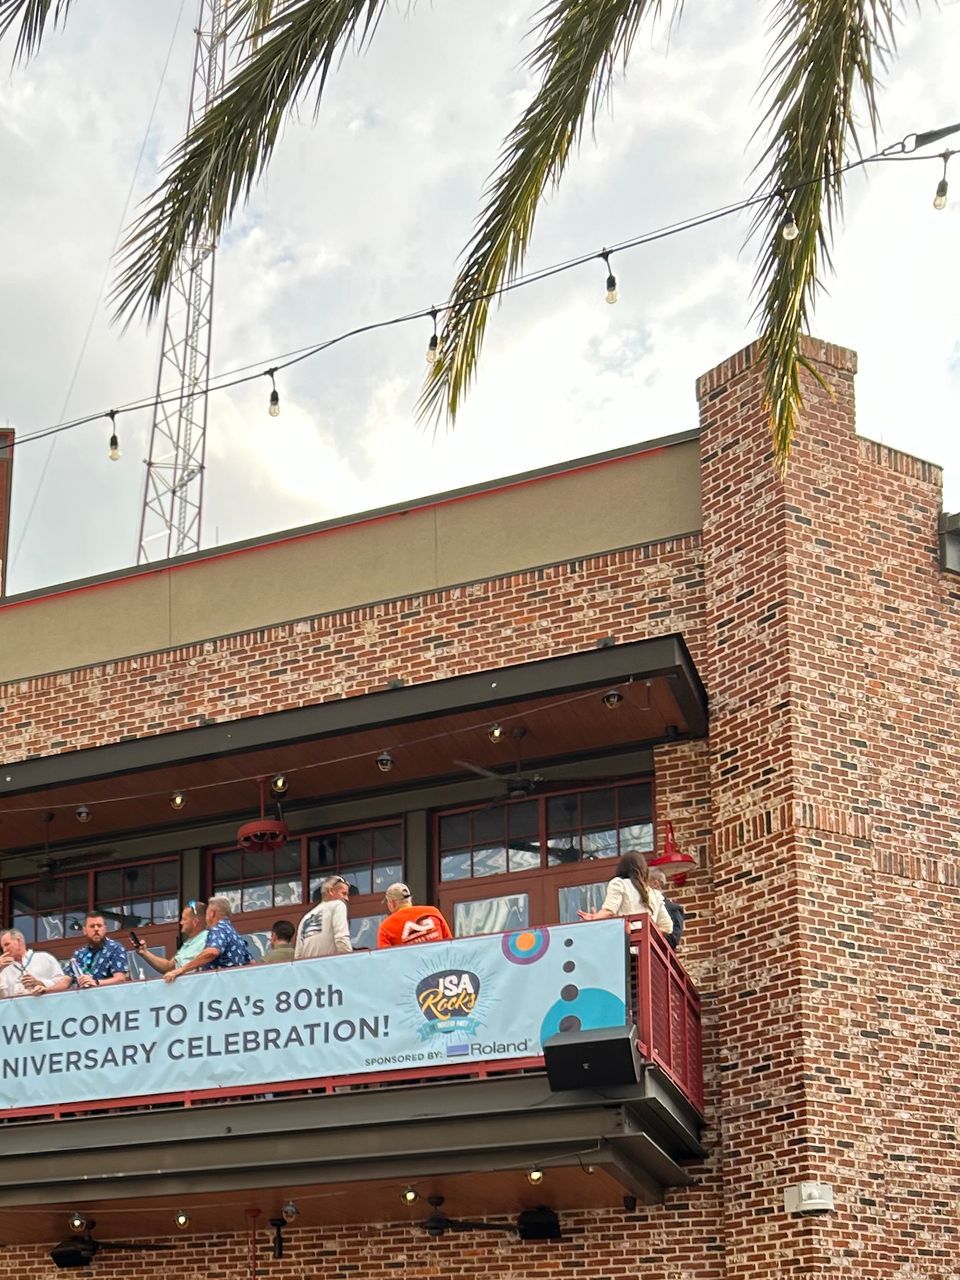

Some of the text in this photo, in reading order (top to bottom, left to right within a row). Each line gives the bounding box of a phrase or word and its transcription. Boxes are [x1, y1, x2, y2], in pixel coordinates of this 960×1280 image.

[439, 973, 475, 997] ISA
[1, 984, 344, 1046] WELCOME TO ISA's 80th
[418, 988, 477, 1021] Rocks
[167, 1015, 390, 1060] CELEBRATION!
[470, 1041, 529, 1056] Roland
[364, 1050, 444, 1067] SPONSORED BY:
